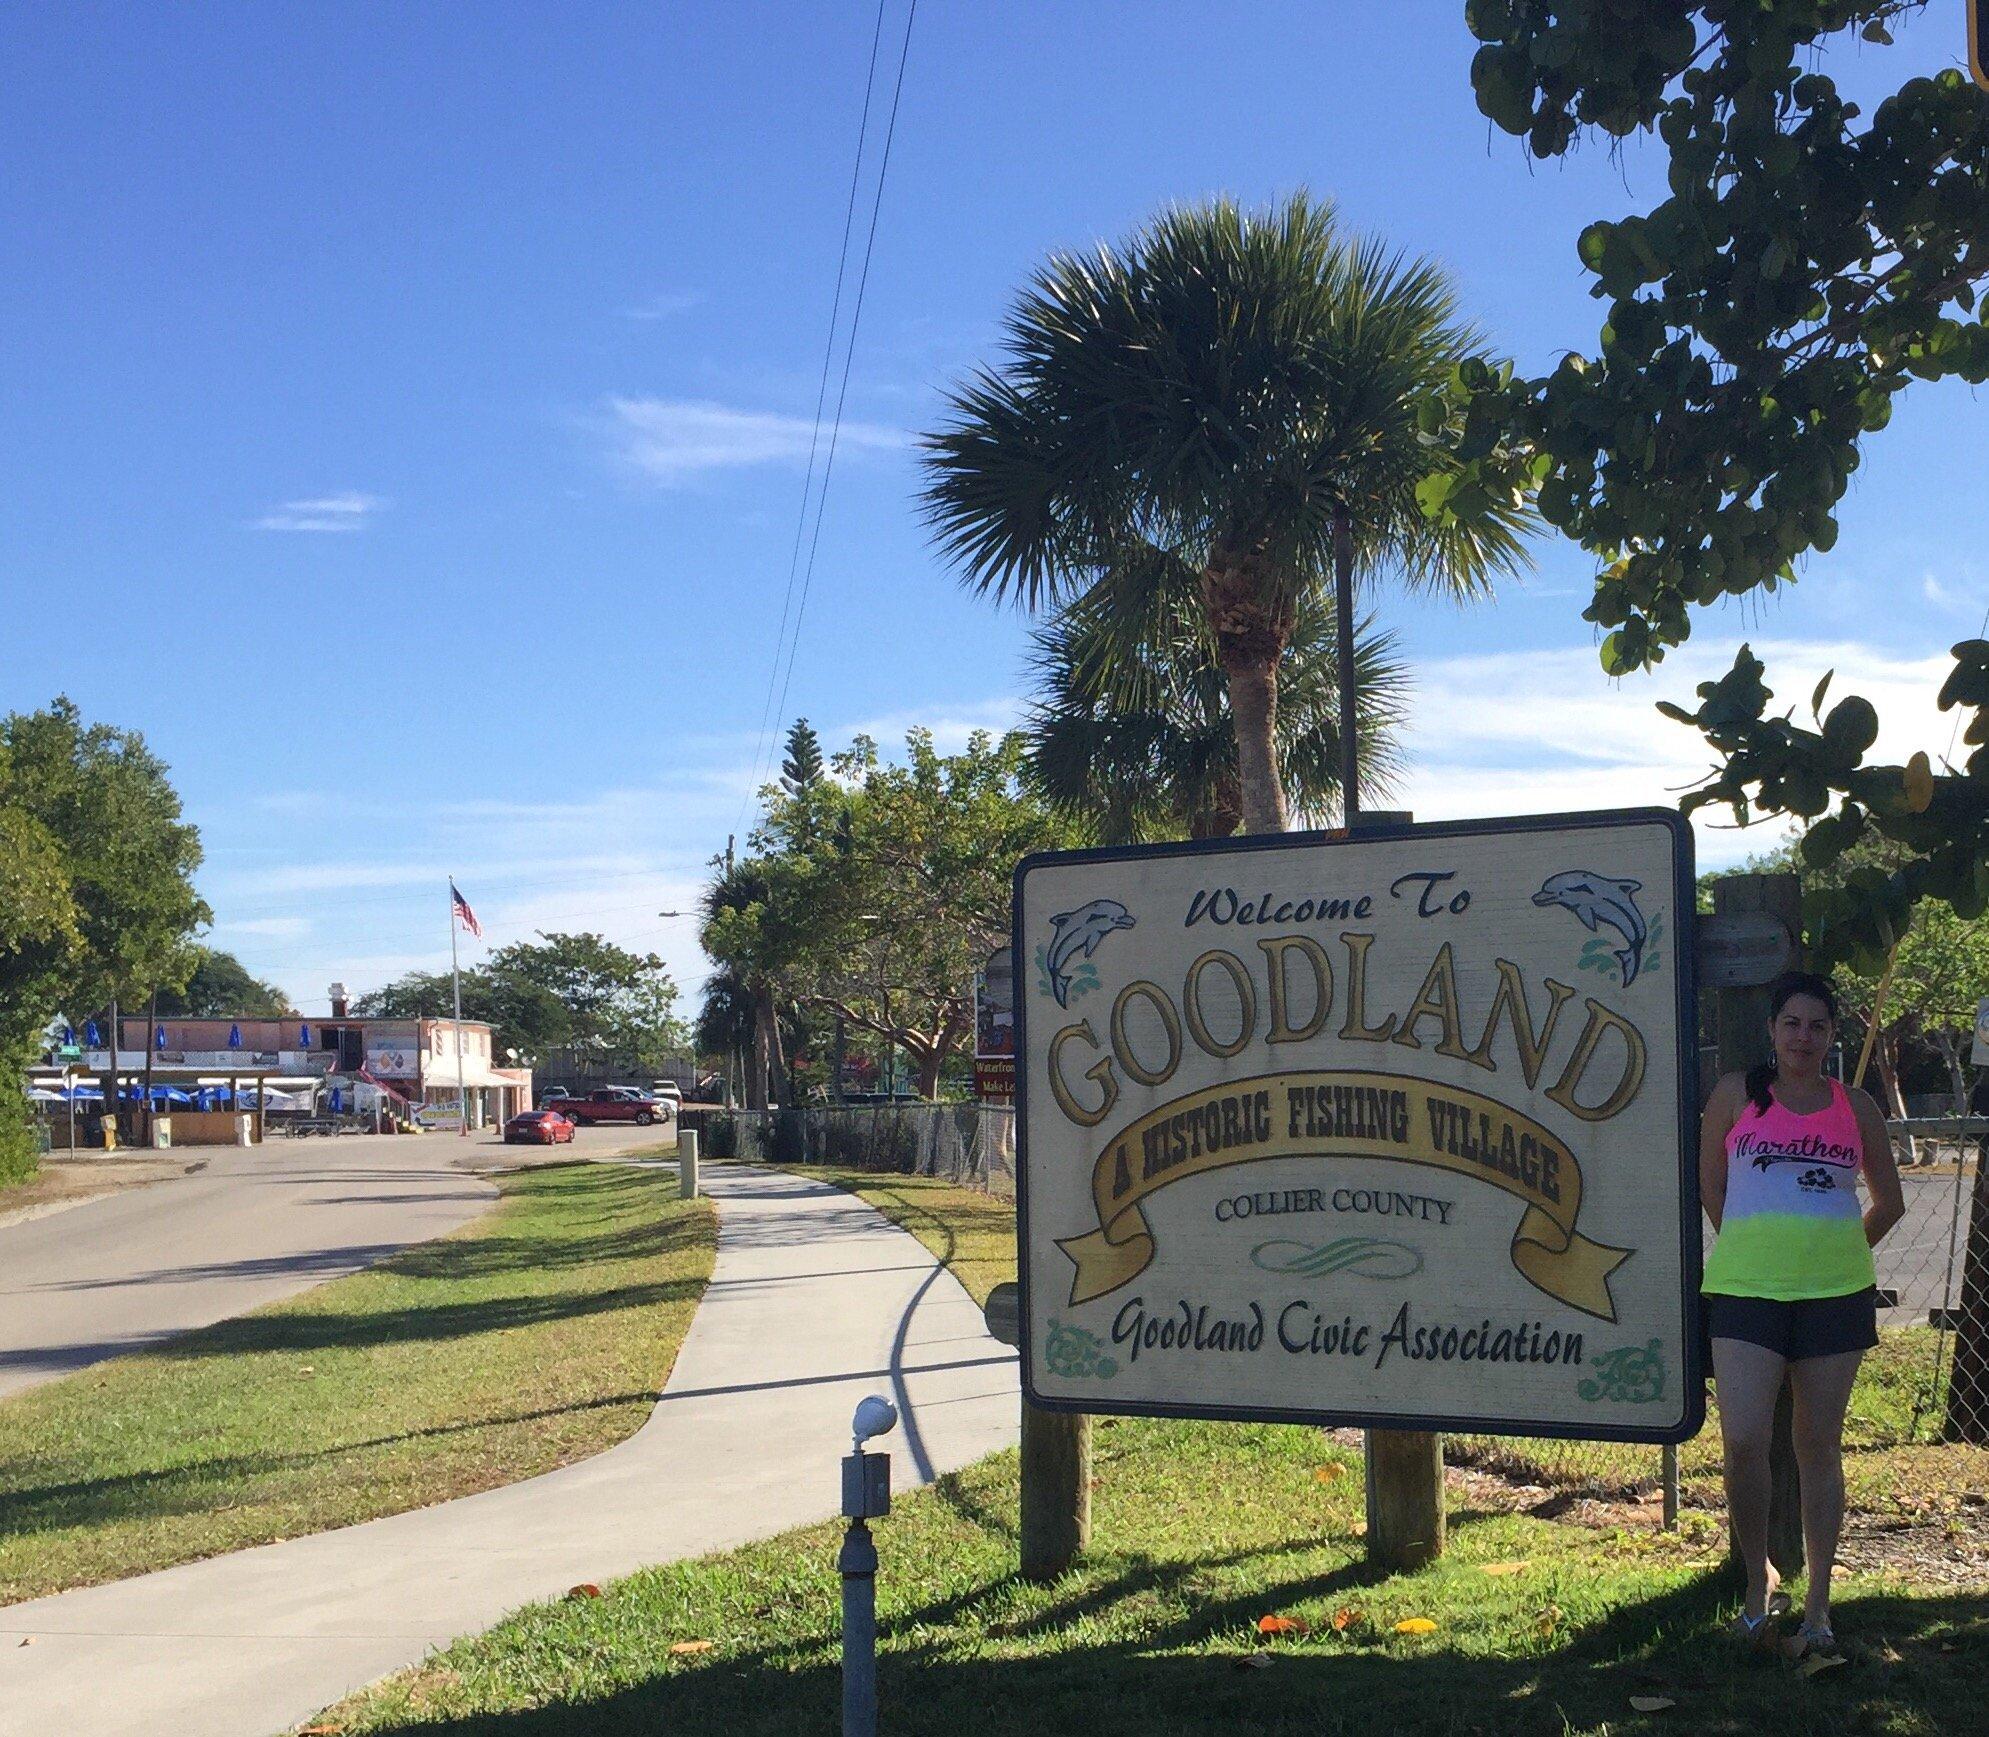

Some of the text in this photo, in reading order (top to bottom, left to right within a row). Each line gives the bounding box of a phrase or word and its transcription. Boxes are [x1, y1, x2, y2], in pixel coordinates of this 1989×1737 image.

[1184, 872, 1471, 927] Welcome To
[1047, 932, 1647, 1127] GOODLAND
[983, 1080, 1003, 1092] Make
[1112, 1085, 1562, 1206] A HISTORIC FISHING VILLAGE
[1735, 1132, 1858, 1163] Marathon
[1215, 1189, 1453, 1225] COLLIER COUNTY
[1111, 1297, 1584, 1369] Goodland Civic Association
